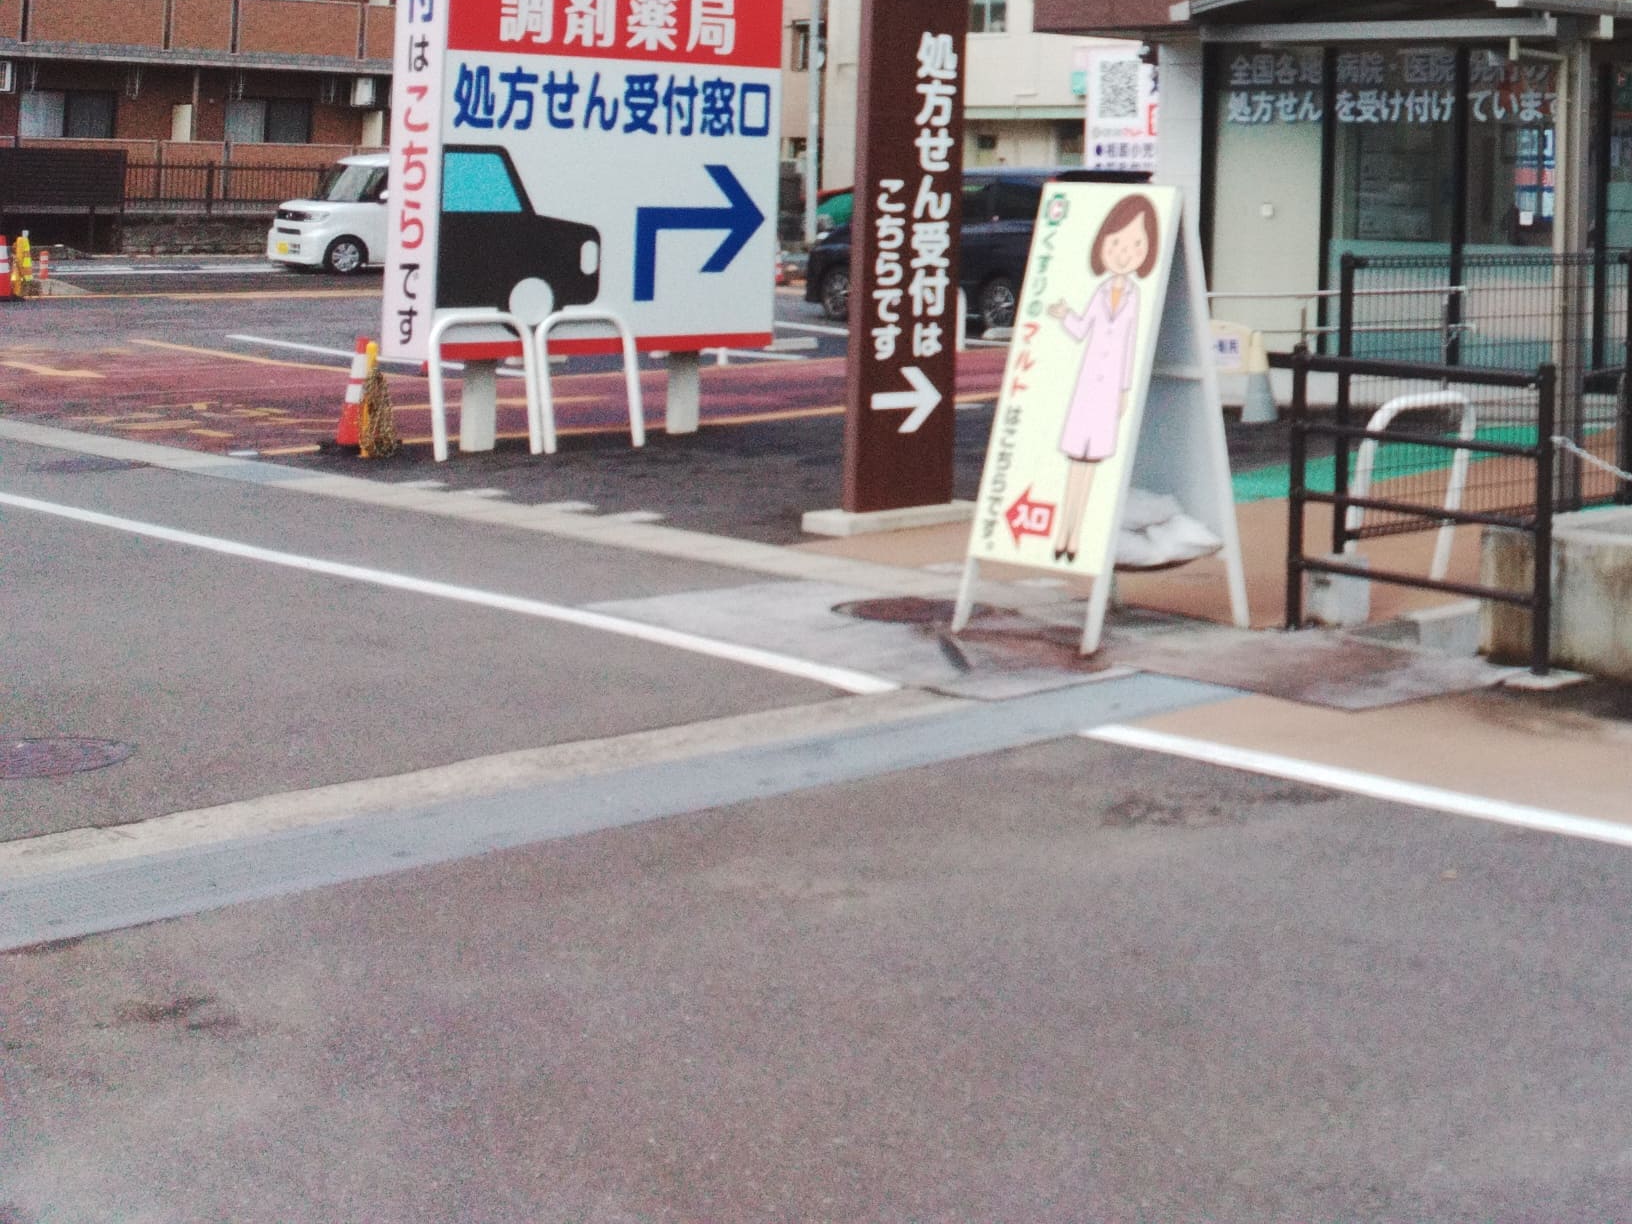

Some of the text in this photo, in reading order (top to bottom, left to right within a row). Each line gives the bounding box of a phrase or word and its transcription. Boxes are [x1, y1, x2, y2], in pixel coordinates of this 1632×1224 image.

[453, 63, 771, 137] 処方せん受付窓口
[908, 31, 958, 357] 処方せん受付は
[874, 178, 906, 360] こちらです
[1011, 504, 1051, 532] 入口
